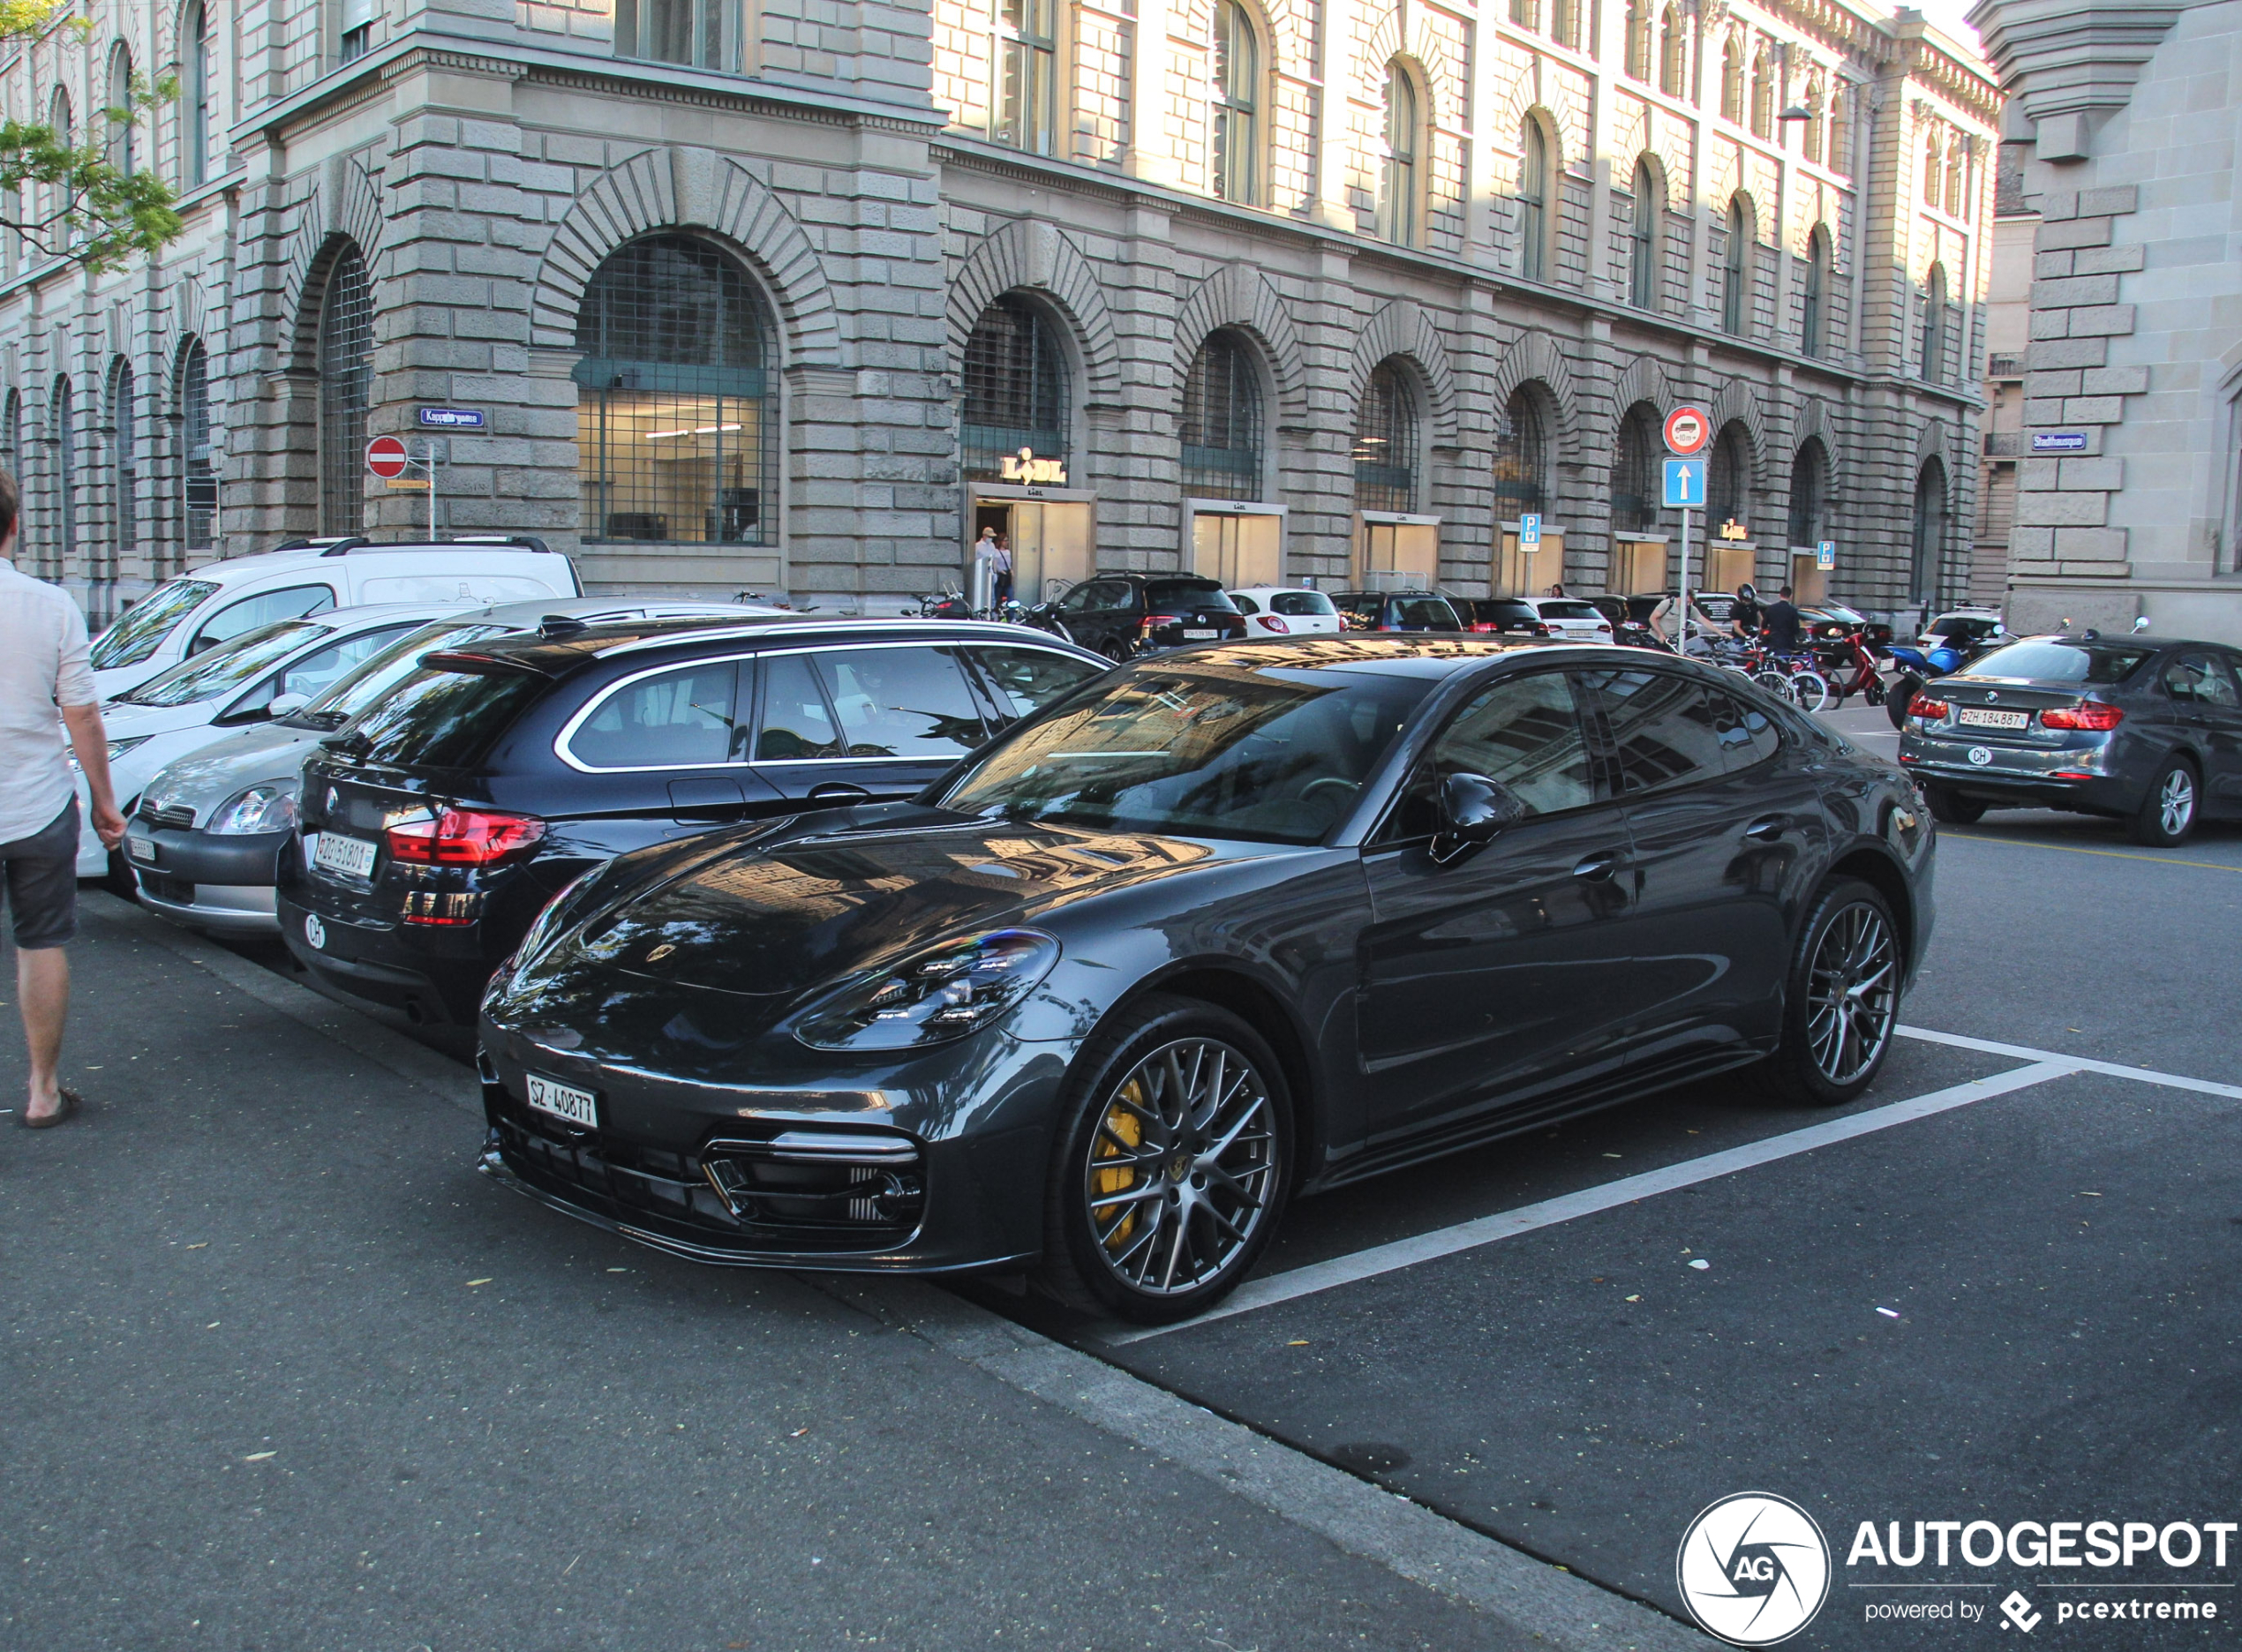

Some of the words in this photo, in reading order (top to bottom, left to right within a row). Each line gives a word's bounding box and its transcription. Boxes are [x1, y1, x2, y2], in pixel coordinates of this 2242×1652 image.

[1527, 516, 1536, 531] P
[1823, 543, 1831, 554] P
[1973, 749, 1986, 762] CH
[309, 918, 321, 945] CH
